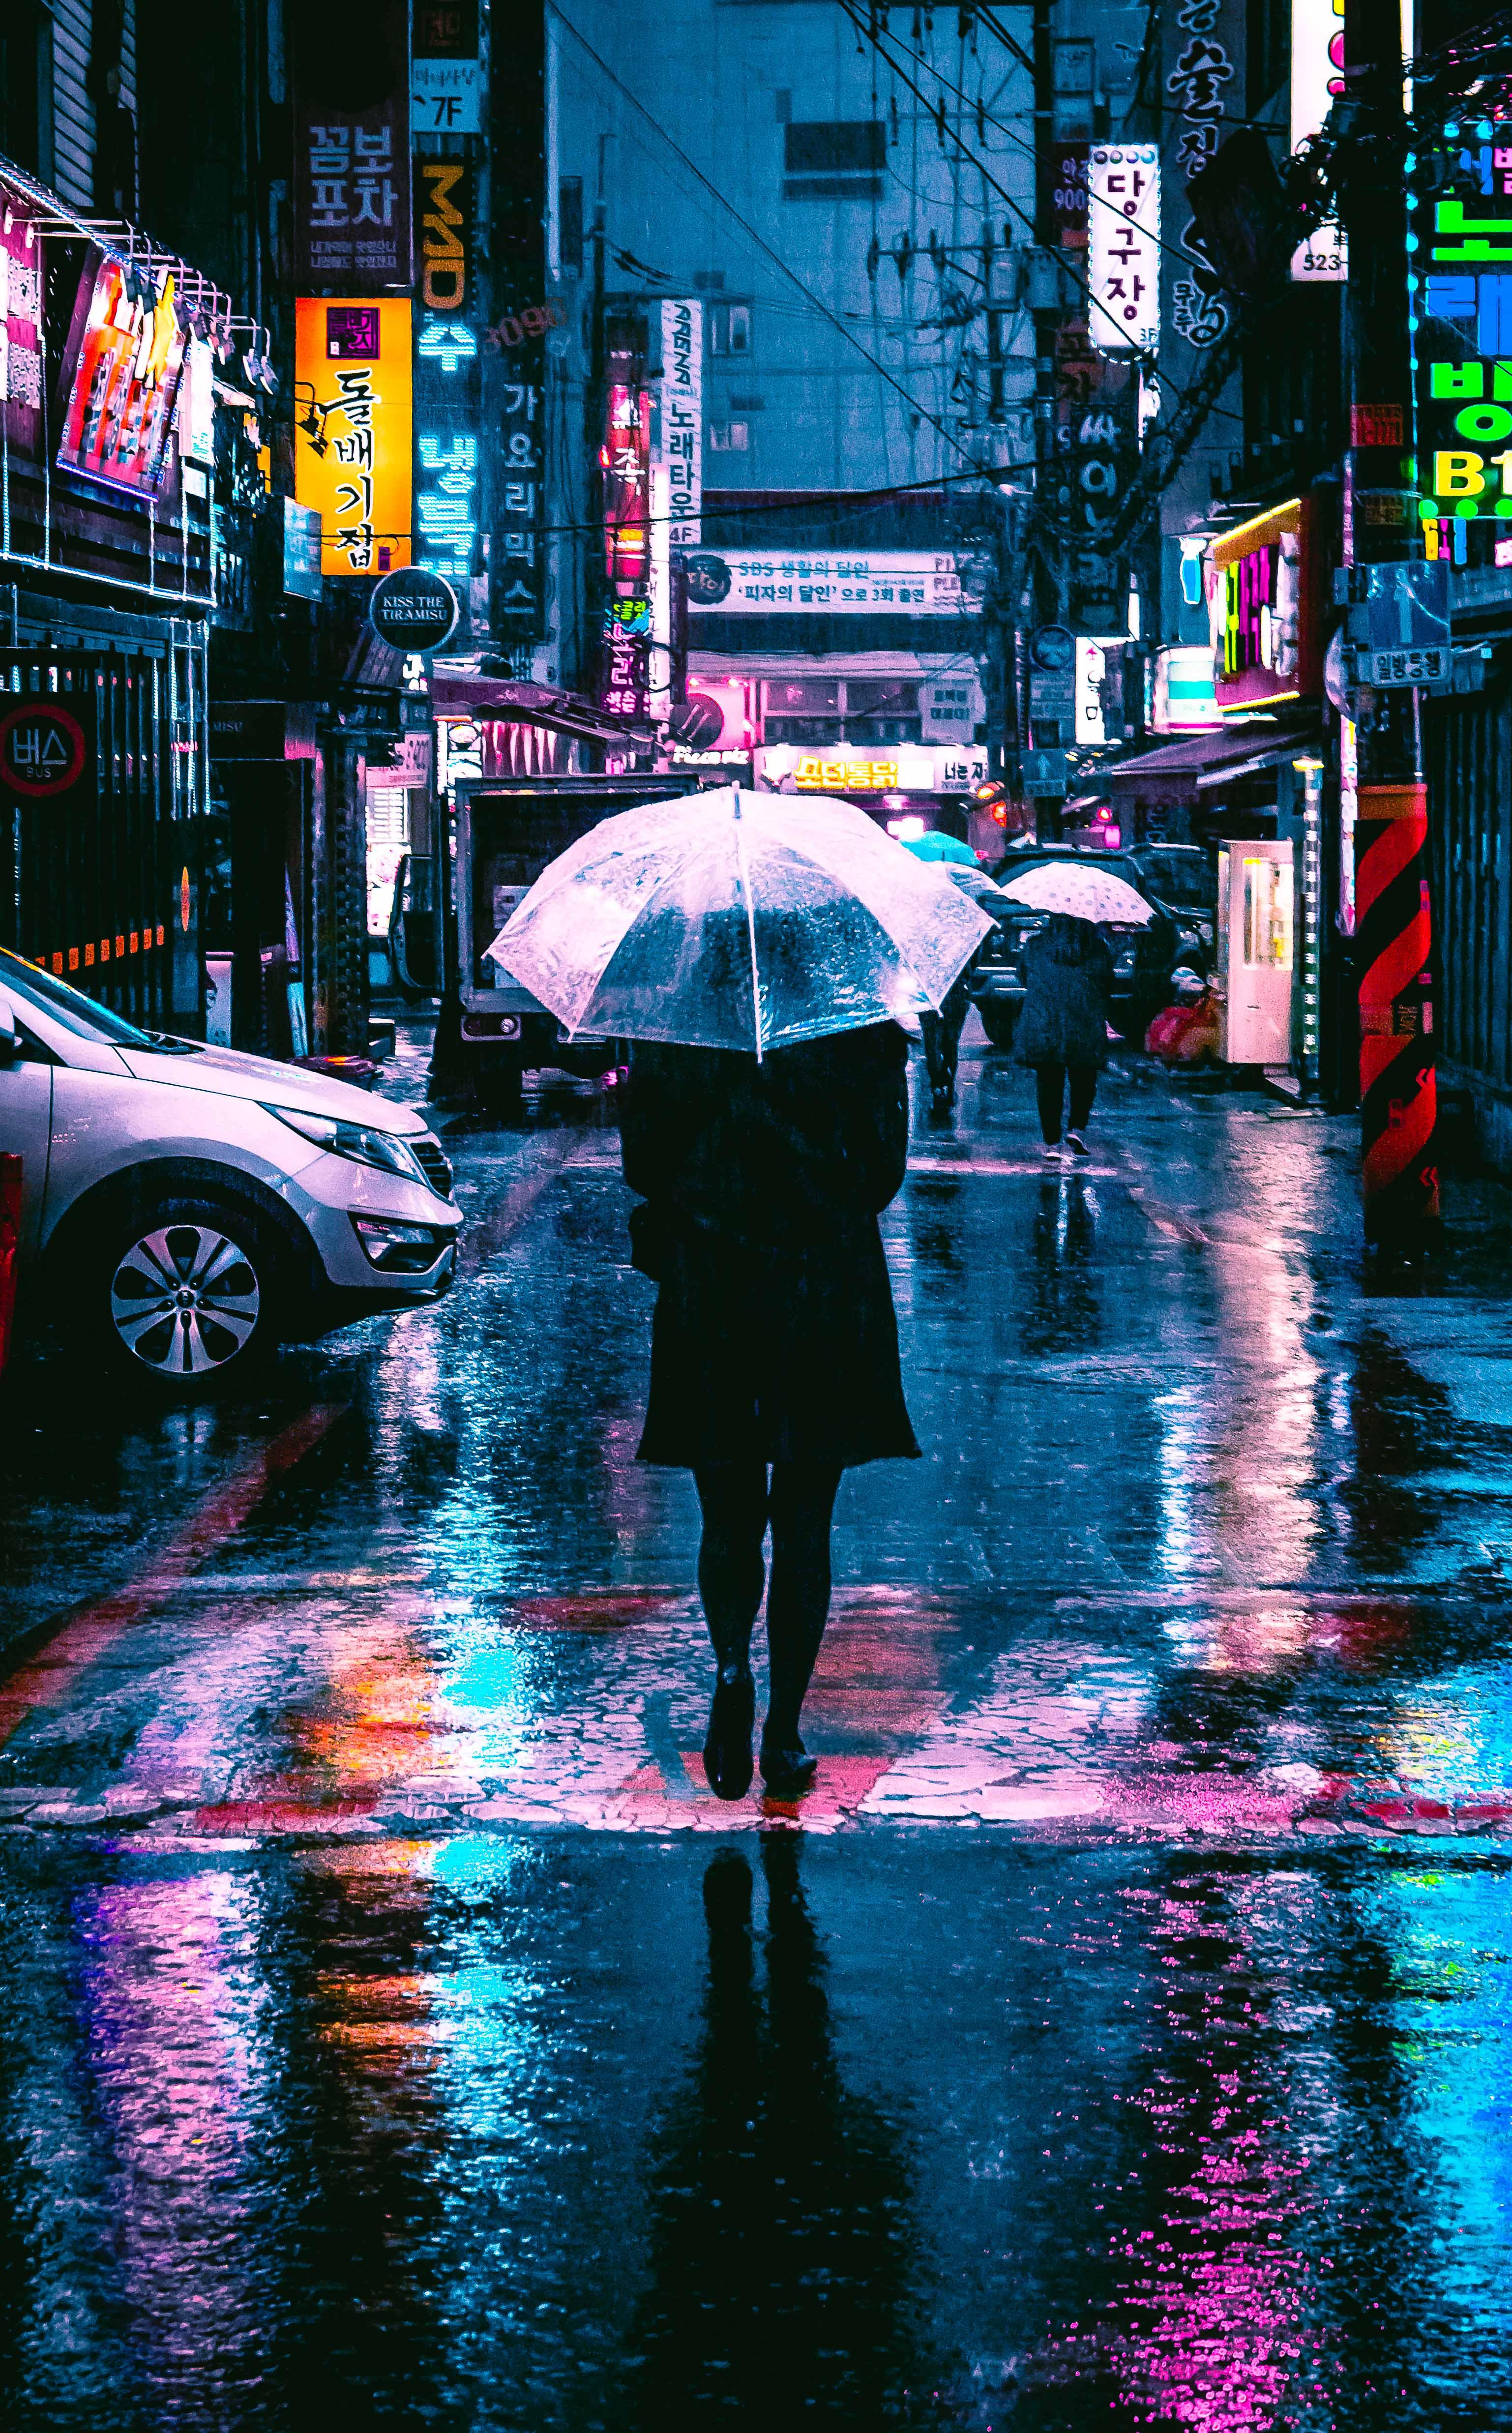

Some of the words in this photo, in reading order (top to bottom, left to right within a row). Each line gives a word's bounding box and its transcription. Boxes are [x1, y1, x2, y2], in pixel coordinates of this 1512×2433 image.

[310, 179, 398, 227] 포차
[1107, 170, 1146, 321] 당구장
[320, 369, 382, 569] 돌배기집
[1433, 450, 1512, 496] B1
[504, 384, 536, 614] 가요리믹스
[739, 561, 774, 577] SBS
[381, 609, 448, 621] TIRAMISU
[383, 596, 414, 607] KISS
[416, 596, 445, 607] THE
[1376, 651, 1441, 681] 일방통행
[13, 729, 67, 766] 버스
[26, 767, 52, 779] BUS
